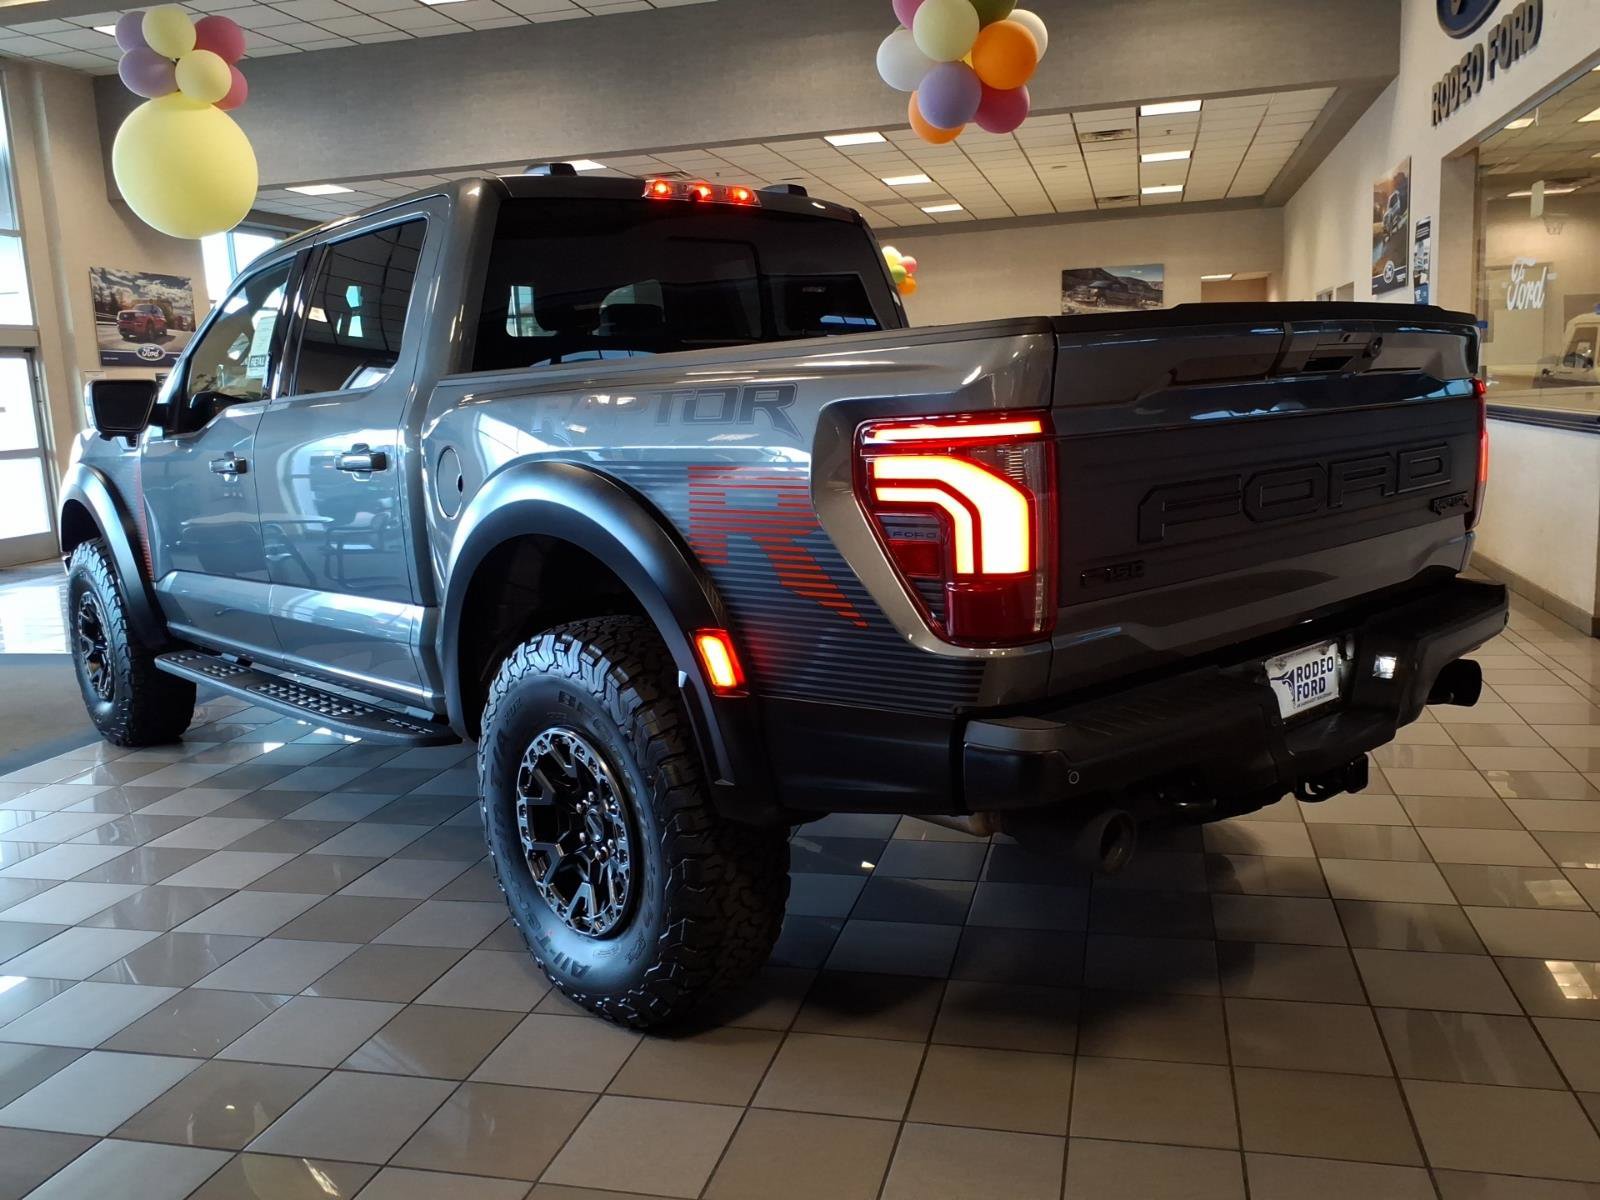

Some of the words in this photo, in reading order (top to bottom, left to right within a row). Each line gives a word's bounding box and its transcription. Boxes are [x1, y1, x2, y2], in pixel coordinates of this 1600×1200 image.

[1432, 43, 1484, 126] RODEO
[1487, 0, 1543, 81] FORD
[1507, 256, 1547, 311] Ford
[1137, 443, 1451, 544] FORD
[893, 530, 937, 539] FORD
[1296, 656, 1334, 683] RODEO
[1297, 676, 1326, 702] FORD
